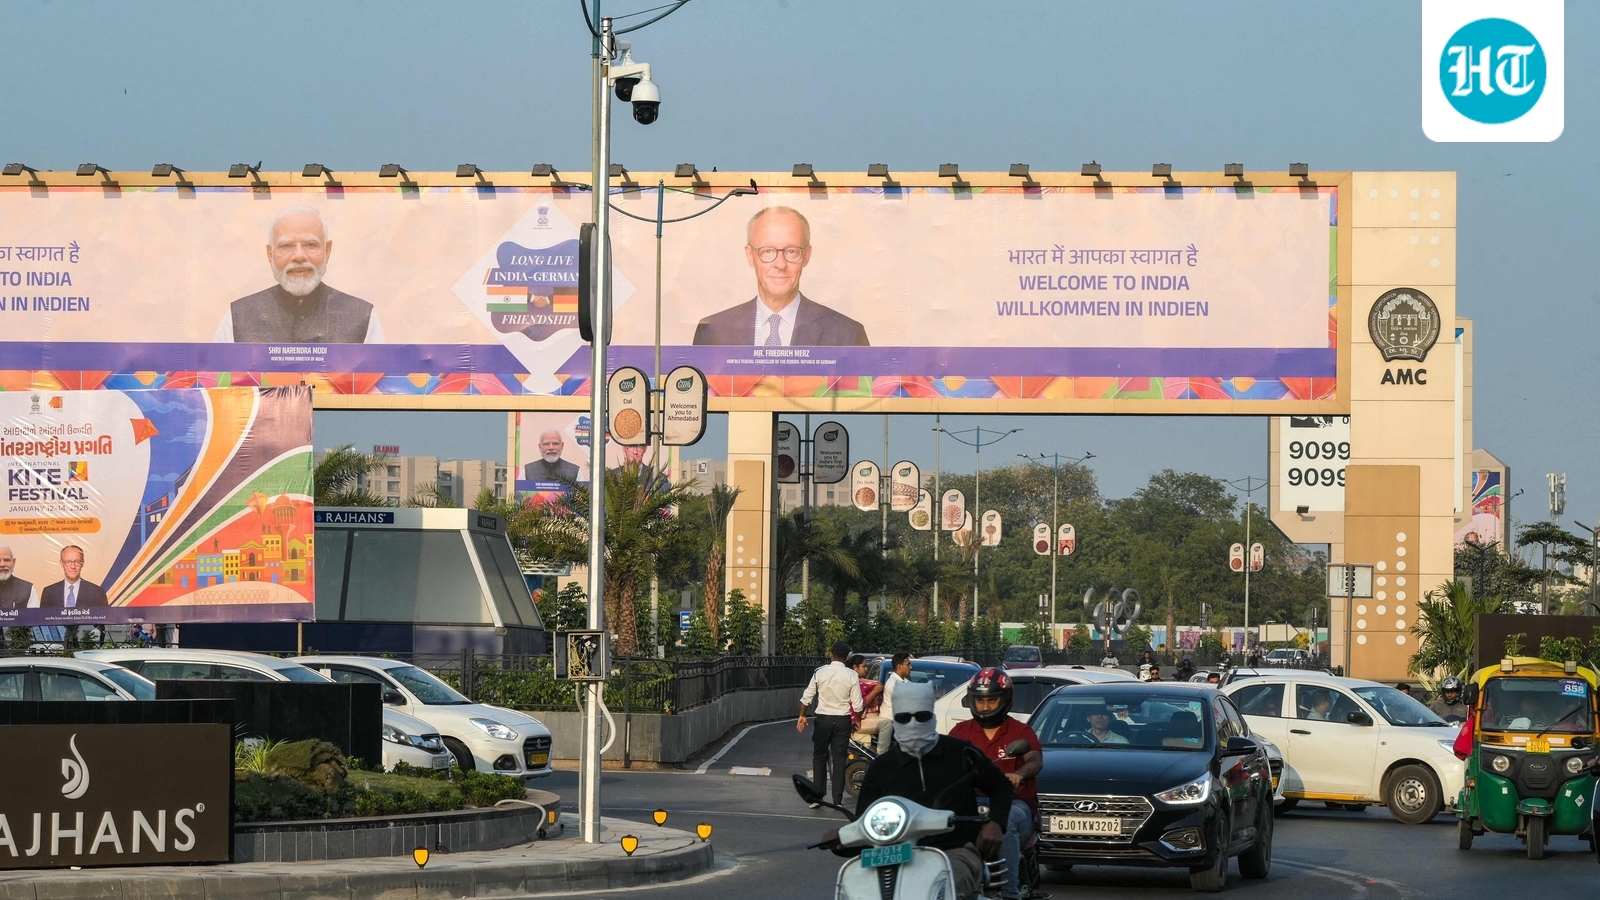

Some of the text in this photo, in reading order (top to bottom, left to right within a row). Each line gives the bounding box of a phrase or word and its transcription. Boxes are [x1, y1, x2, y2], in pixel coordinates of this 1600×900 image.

[15, 246, 65, 261] स्वागत
[68, 240, 81, 264] है
[1008, 243, 1199, 267] भारत में आपका स्वागत है
[510, 255, 574, 266] LONG LIVE
[0, 271, 72, 287] TO INDIA
[1018, 275, 1190, 291] WELCOME TO INDIA
[11, 296, 28, 311] IN
[33, 296, 90, 312] INDIEN
[996, 301, 1209, 316] WILLKOMMEN IN INDIEN
[501, 314, 576, 325] FRIENDSHIP
[268, 346, 328, 354] SHRI NARENDRA MODI
[753, 349, 810, 357] MR. FRIEDRICH MERZ
[1380, 368, 1427, 385] AMC
[0, 435, 113, 458] ંતરરાષ્ટ્રીય પ્રગતિ
[1289, 441, 1350, 460] 9099
[8, 468, 61, 486] KITE
[1288, 468, 1345, 487] 9099
[9, 487, 89, 501] FESTIVAL
[1565, 684, 1584, 694] 858
[1058, 820, 1119, 831] GJ01KW3202
[871, 854, 903, 866] L3700
